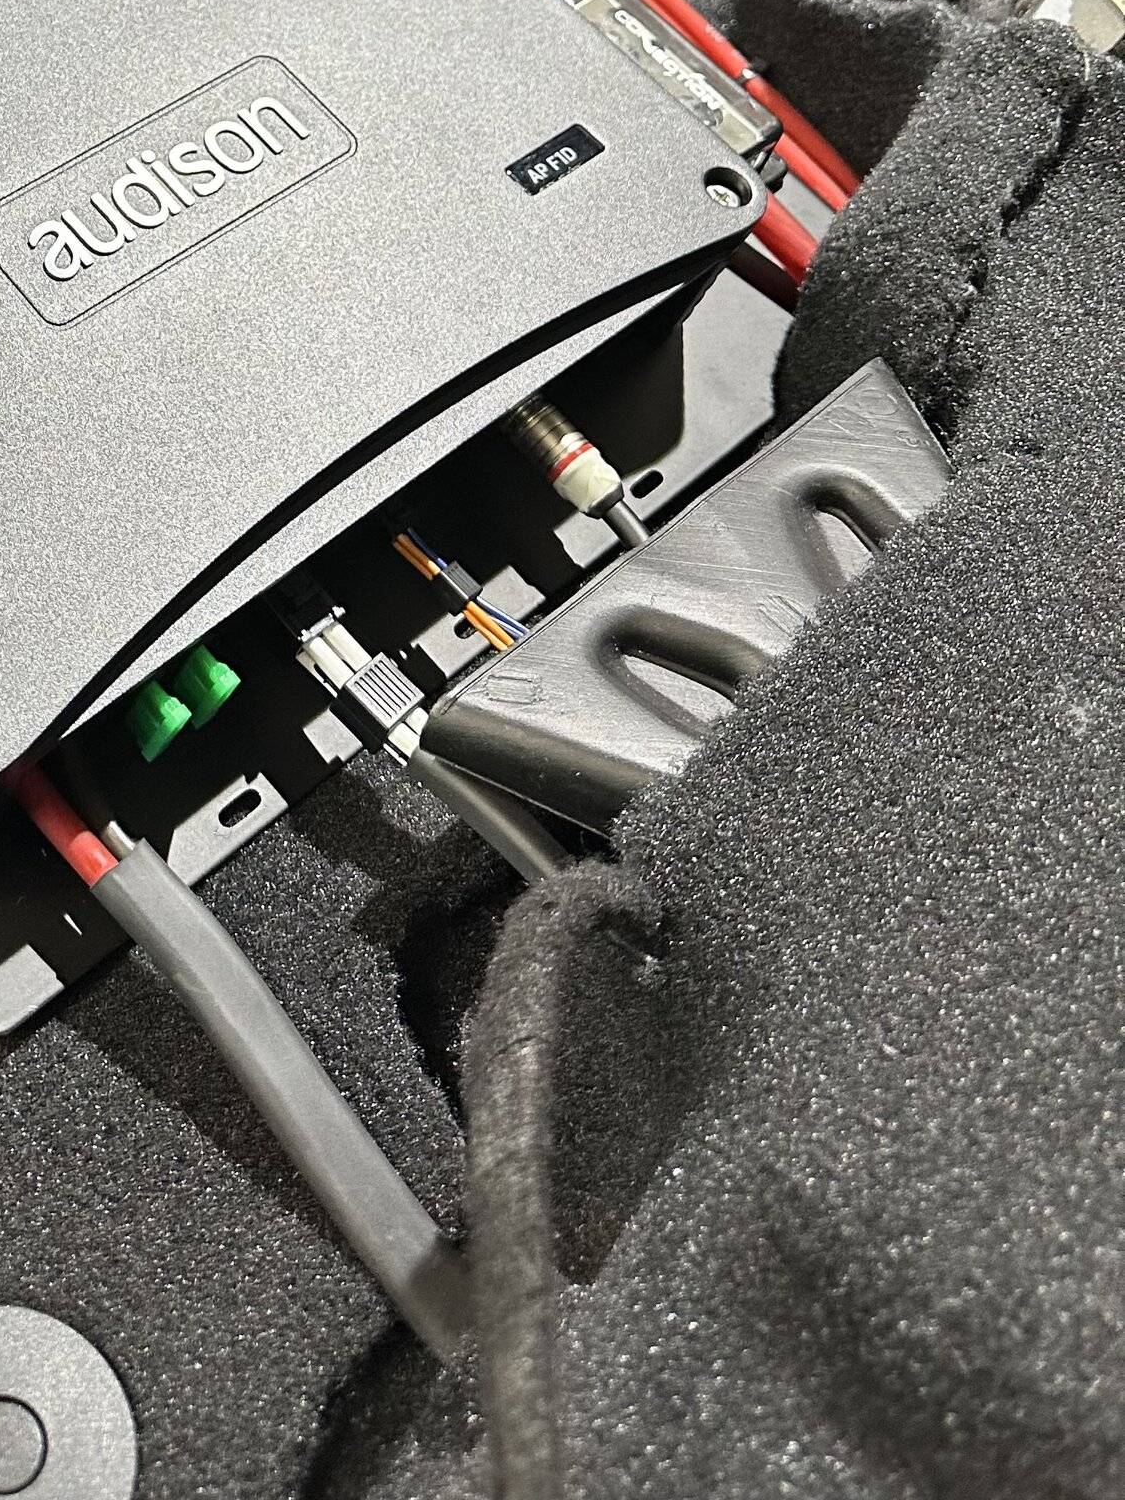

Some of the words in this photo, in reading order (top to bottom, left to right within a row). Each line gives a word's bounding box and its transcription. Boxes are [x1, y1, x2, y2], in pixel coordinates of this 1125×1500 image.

[27, 97, 311, 282] audison
[526, 162, 550, 185] AP
[545, 146, 578, 171] F1D
